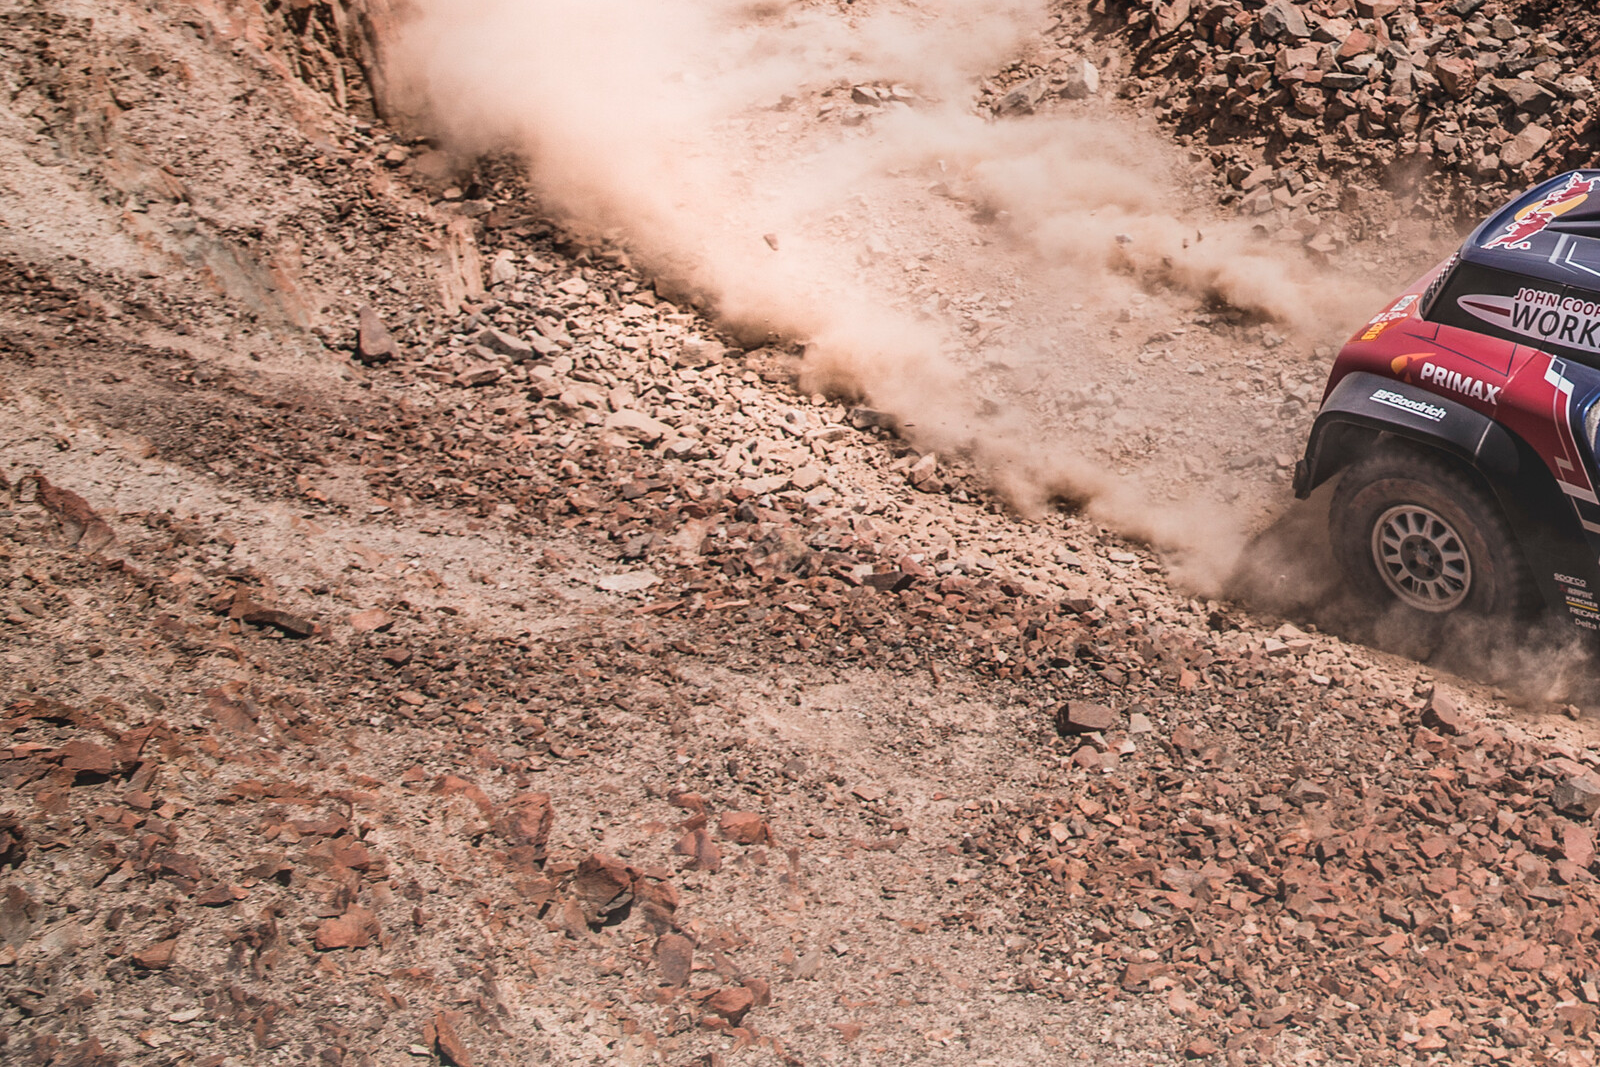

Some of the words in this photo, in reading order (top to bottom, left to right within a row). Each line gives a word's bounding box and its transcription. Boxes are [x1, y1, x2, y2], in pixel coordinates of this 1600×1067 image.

[1514, 287, 1560, 308] JOHN
[1420, 361, 1502, 405] PRIMAX
[1369, 388, 1447, 420] BFGoodrich
[1575, 618, 1597, 630] Delta
